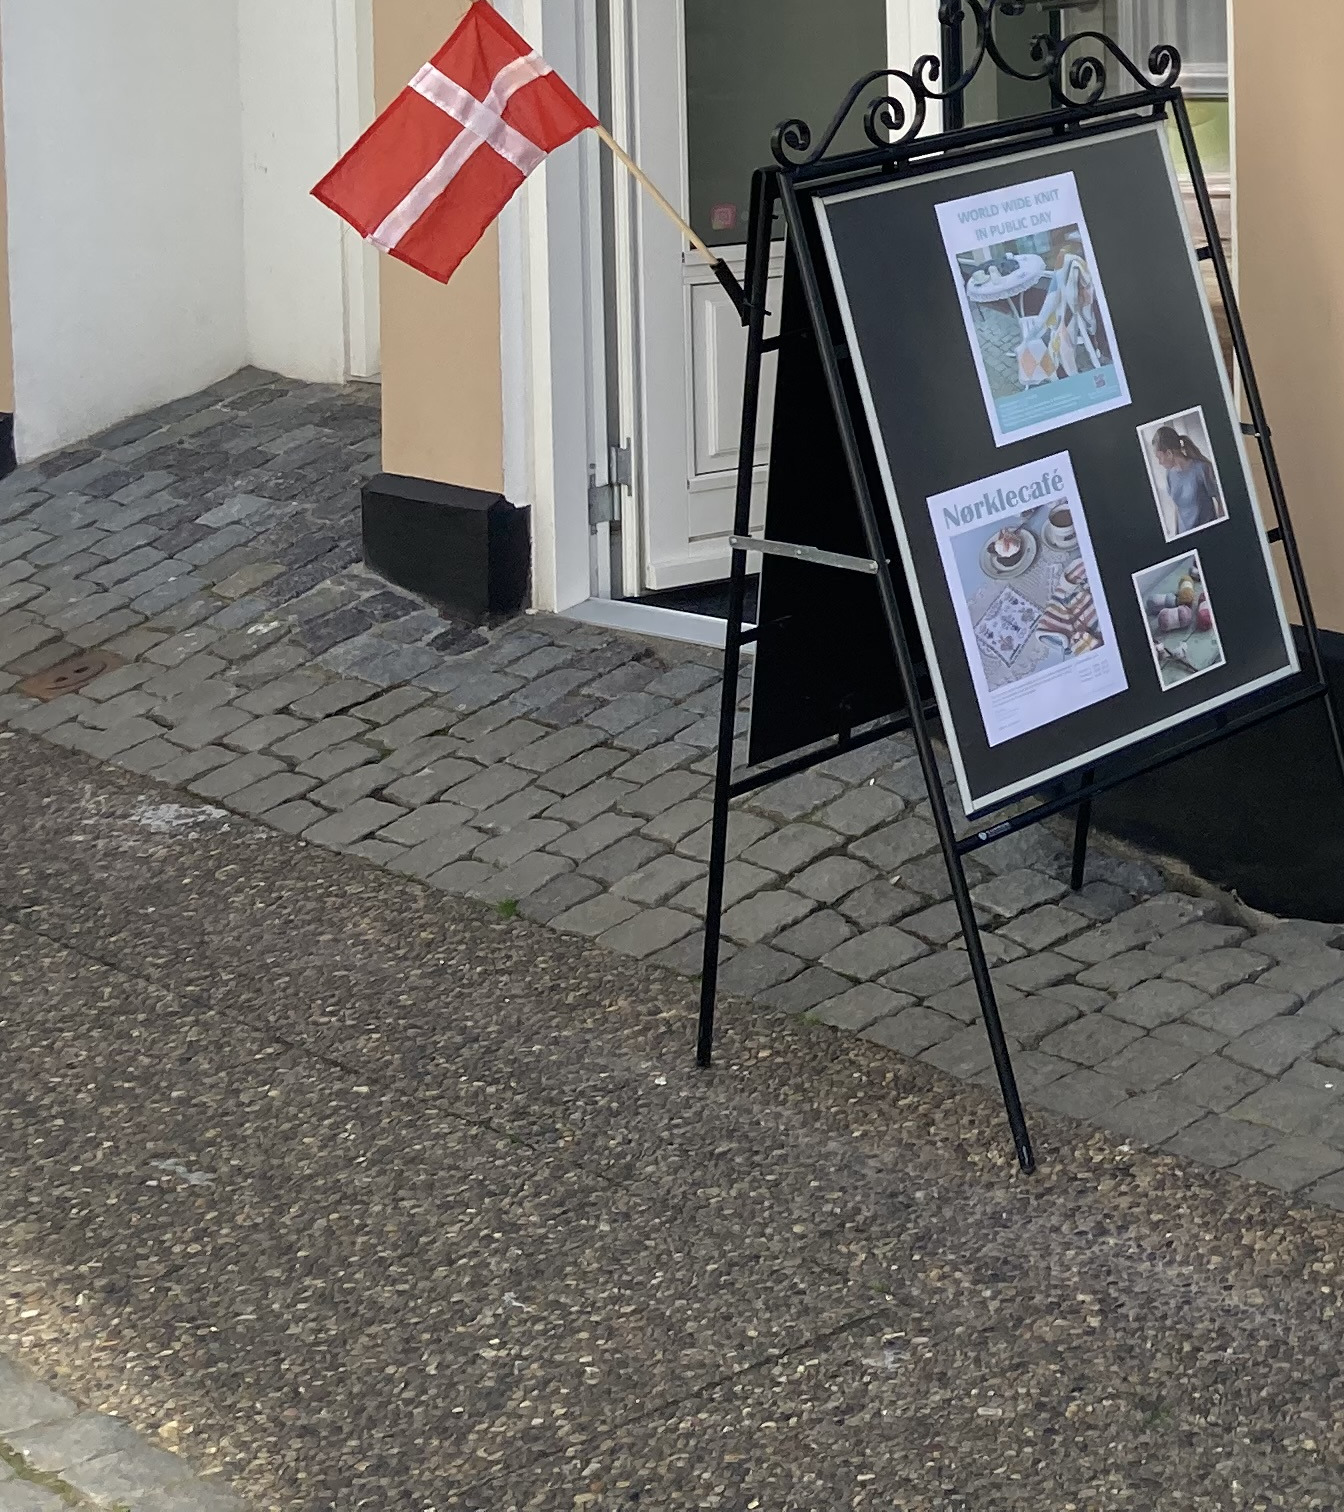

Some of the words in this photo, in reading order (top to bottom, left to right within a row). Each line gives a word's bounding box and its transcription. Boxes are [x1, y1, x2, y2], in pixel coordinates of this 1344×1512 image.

[958, 204, 999, 224] WORLD
[1001, 196, 1032, 213] WIDE
[1034, 188, 1059, 205] KNIT
[975, 228, 988, 241] IN
[990, 217, 1028, 237] PUBLIC
[1030, 211, 1052, 227] DAY
[943, 468, 1064, 529] Nørklecafé
